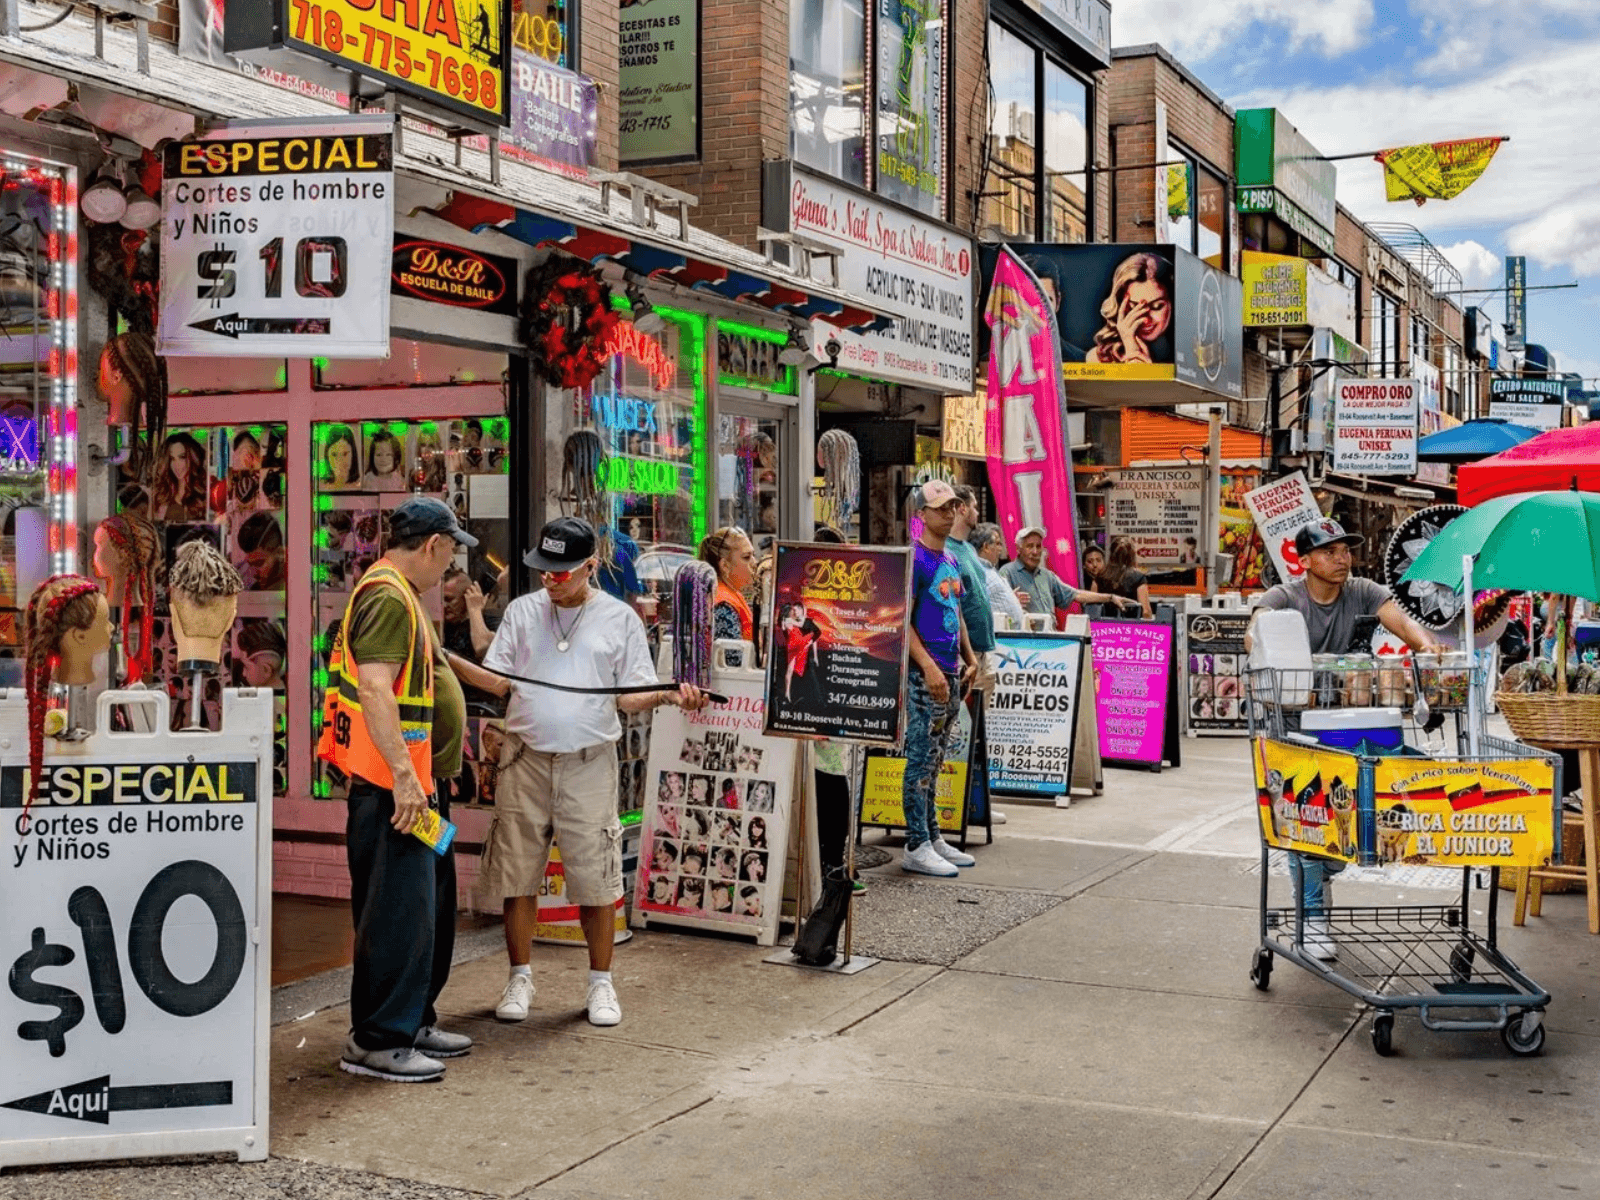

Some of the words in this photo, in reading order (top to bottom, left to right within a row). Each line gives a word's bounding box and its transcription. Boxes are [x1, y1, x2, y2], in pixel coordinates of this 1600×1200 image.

[668, 15, 681, 26] ES
[292, 0, 497, 109] 718-775-7698
[663, 40, 675, 51] TE
[518, 61, 582, 114] BAILE
[179, 137, 379, 175] ESPECIAL
[175, 180, 252, 205] Cortes
[258, 180, 285, 201] de
[292, 178, 386, 201] hombre
[1242, 189, 1250, 210] 2
[1250, 188, 1274, 210] PISO
[173, 218, 185, 239] y
[192, 210, 259, 235] Niños
[875, 211, 898, 260] Spa
[409, 247, 486, 285] D&R
[400, 273, 449, 293] ESCUELA
[449, 283, 465, 296] DE
[464, 286, 495, 301] BAILE
[865, 265, 898, 301] ACRYLIC
[899, 276, 916, 306] TIPS
[920, 282, 936, 312] SILK
[938, 288, 964, 321] WAXING
[213, 318, 249, 332] Aqui
[1250, 311, 1304, 324] 718-651-0101
[940, 326, 971, 358] MASSAGE
[1080, 366, 1106, 377] Salon
[1341, 385, 1387, 400] COMPRO
[1389, 385, 1413, 400] ORO
[1492, 380, 1522, 394] CENTRO
[1522, 380, 1562, 396] NATURISTA
[1505, 393, 1516, 402] MI
[1518, 394, 1545, 403] SALUD
[1338, 428, 1374, 439] EUGENIA
[1375, 428, 1413, 439] PERUANA
[1358, 440, 1392, 451] UNISEX
[1340, 452, 1410, 460] 845-777-5293
[1120, 471, 1192, 481] FRANCISCO
[1165, 482, 1171, 490] Y
[1172, 481, 1200, 490] SALON
[1135, 491, 1177, 499] UNISEX
[1252, 478, 1301, 505] EUGENIA
[1256, 488, 1305, 513] PERUANA
[1265, 497, 1304, 519] UNISEX
[1266, 519, 1289, 537] CORTE
[803, 558, 876, 590] D&R
[1133, 627, 1165, 642] NAILS
[831, 654, 862, 664] Bachata
[995, 649, 1068, 672] Alexa
[830, 664, 880, 677] Duranguense
[827, 692, 897, 711] 347.640.8499
[688, 712, 742, 731] Beauty
[779, 710, 803, 721] 89-10
[803, 712, 843, 726] Roosevelt
[843, 716, 862, 728] Ave,
[863, 718, 879, 730] 2nd
[986, 715, 1067, 724] CONSTRUCTION
[1008, 744, 1069, 760] 424-5552
[1007, 758, 1068, 773] 424-4441
[21, 764, 244, 806] ESPECIAL
[994, 780, 1041, 791] BASEMENT
[1001, 771, 1044, 784] Roosevelt
[1045, 773, 1062, 784] Ave
[1390, 779, 1410, 795] Con
[1410, 772, 1422, 786] el
[1422, 768, 1445, 781] rico
[1447, 766, 1477, 776] sabor
[1481, 765, 1540, 797] Venezolano
[14, 812, 99, 838] Cortes
[107, 811, 138, 834] de
[146, 808, 244, 833] Hombre
[1300, 804, 1329, 825] CHICHA
[1401, 813, 1446, 832] RICA
[1449, 813, 1528, 833] CHICHA
[13, 842, 29, 868] y
[37, 836, 111, 861] Niños
[1415, 837, 1437, 855] EL
[1442, 837, 1514, 856] JUNIOR
[8, 859, 247, 1059] $10
[47, 1088, 109, 1117] Aqui
